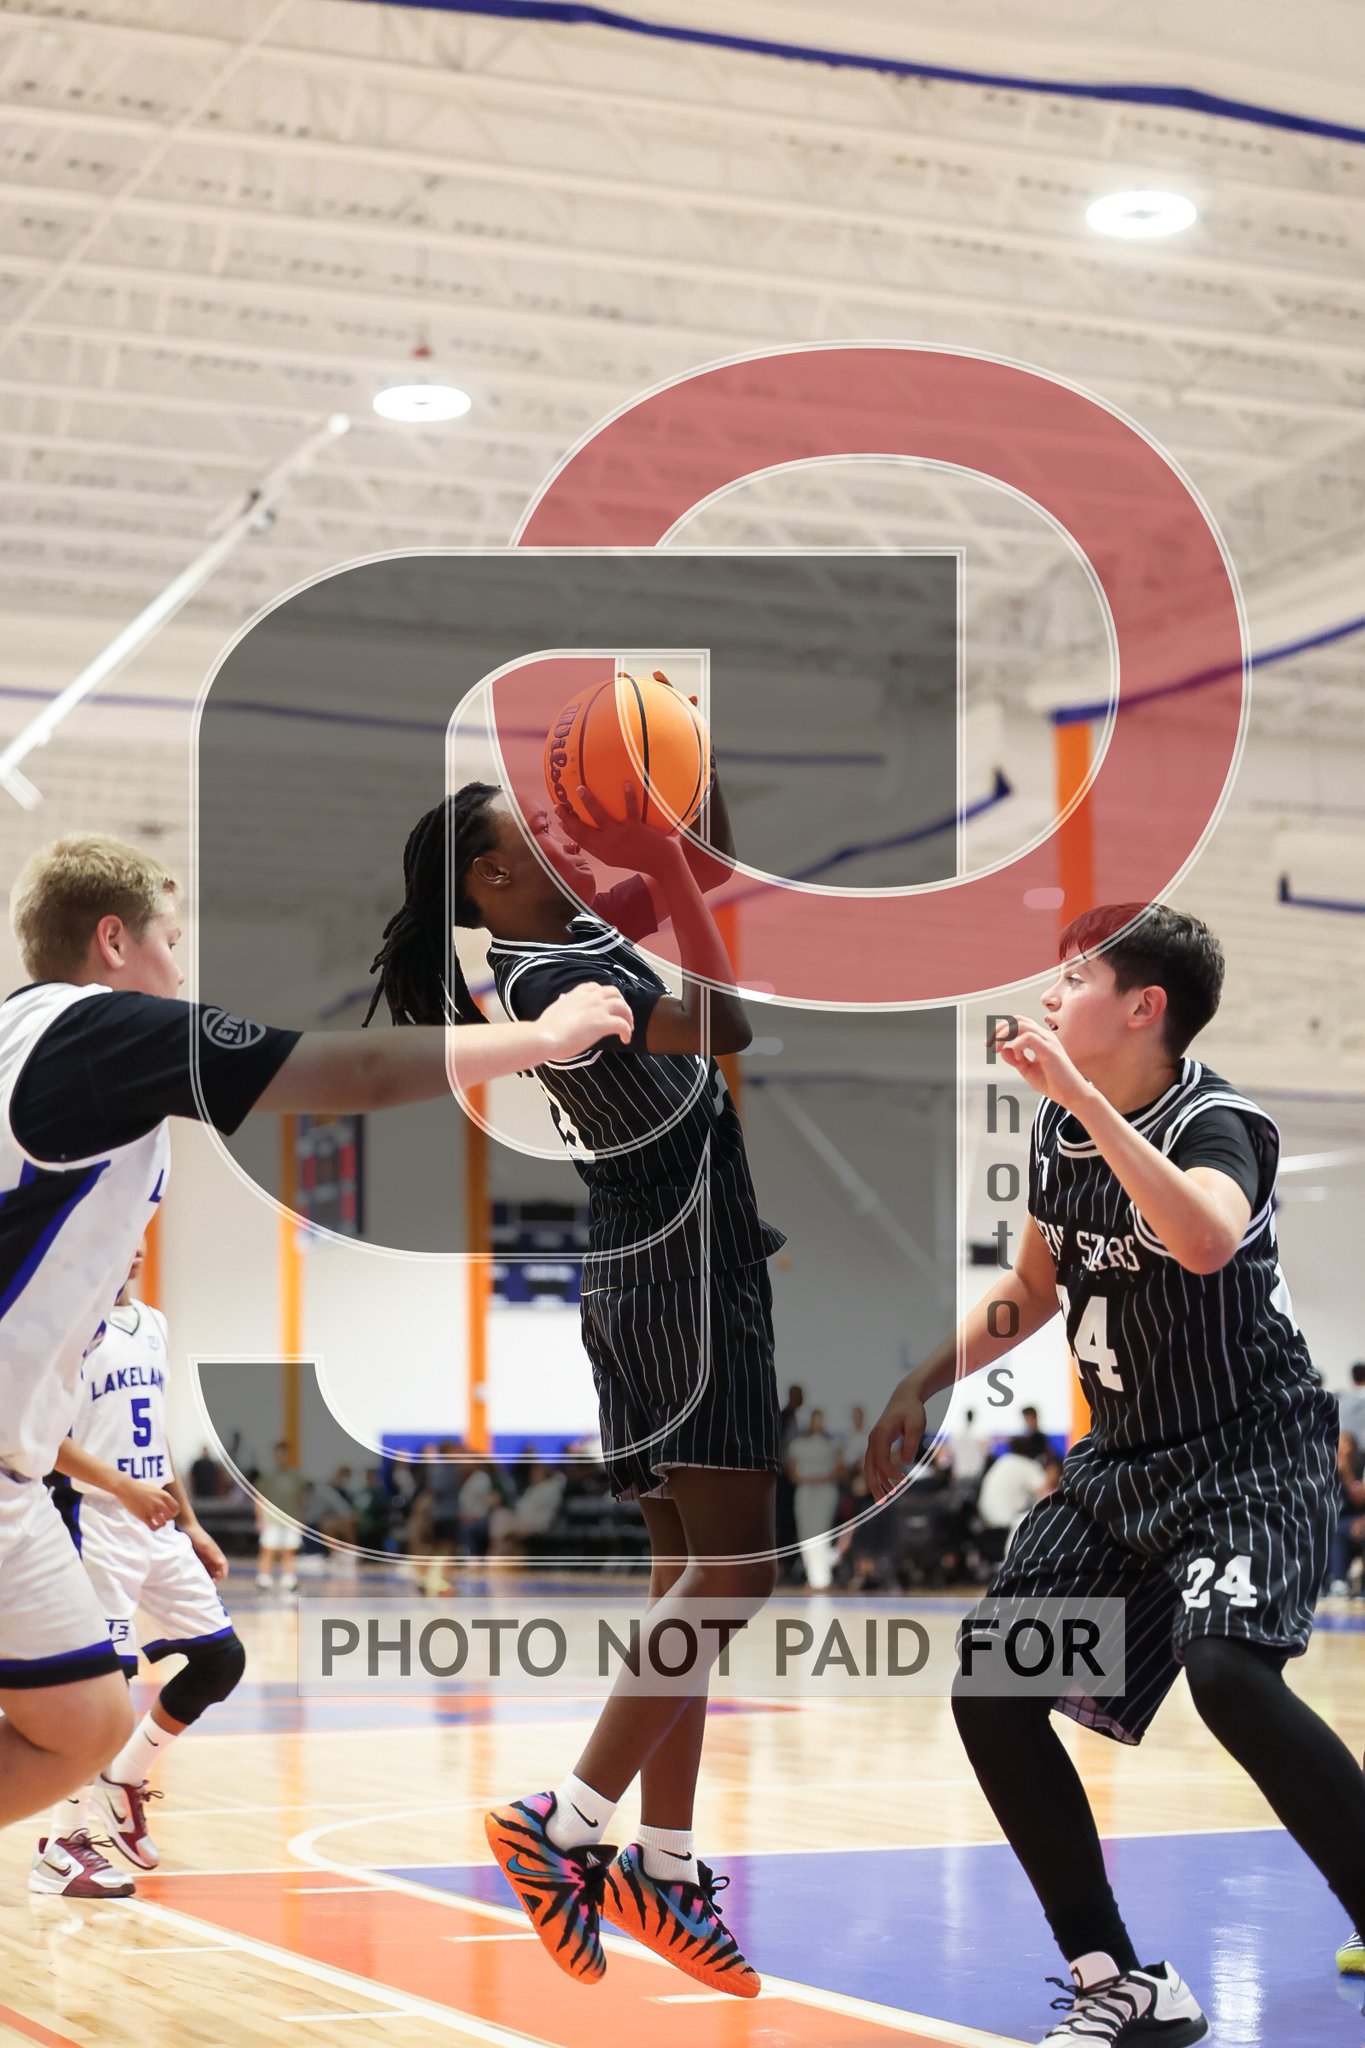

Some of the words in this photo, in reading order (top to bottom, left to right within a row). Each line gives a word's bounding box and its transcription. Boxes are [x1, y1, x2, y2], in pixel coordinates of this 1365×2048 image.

[1056, 1284, 1124, 1392] 4
[91, 1366, 164, 1402] LAKELAN
[131, 1398, 151, 1448] 5
[117, 1455, 164, 1480] ELITE
[1181, 1554, 1258, 1608] 24
